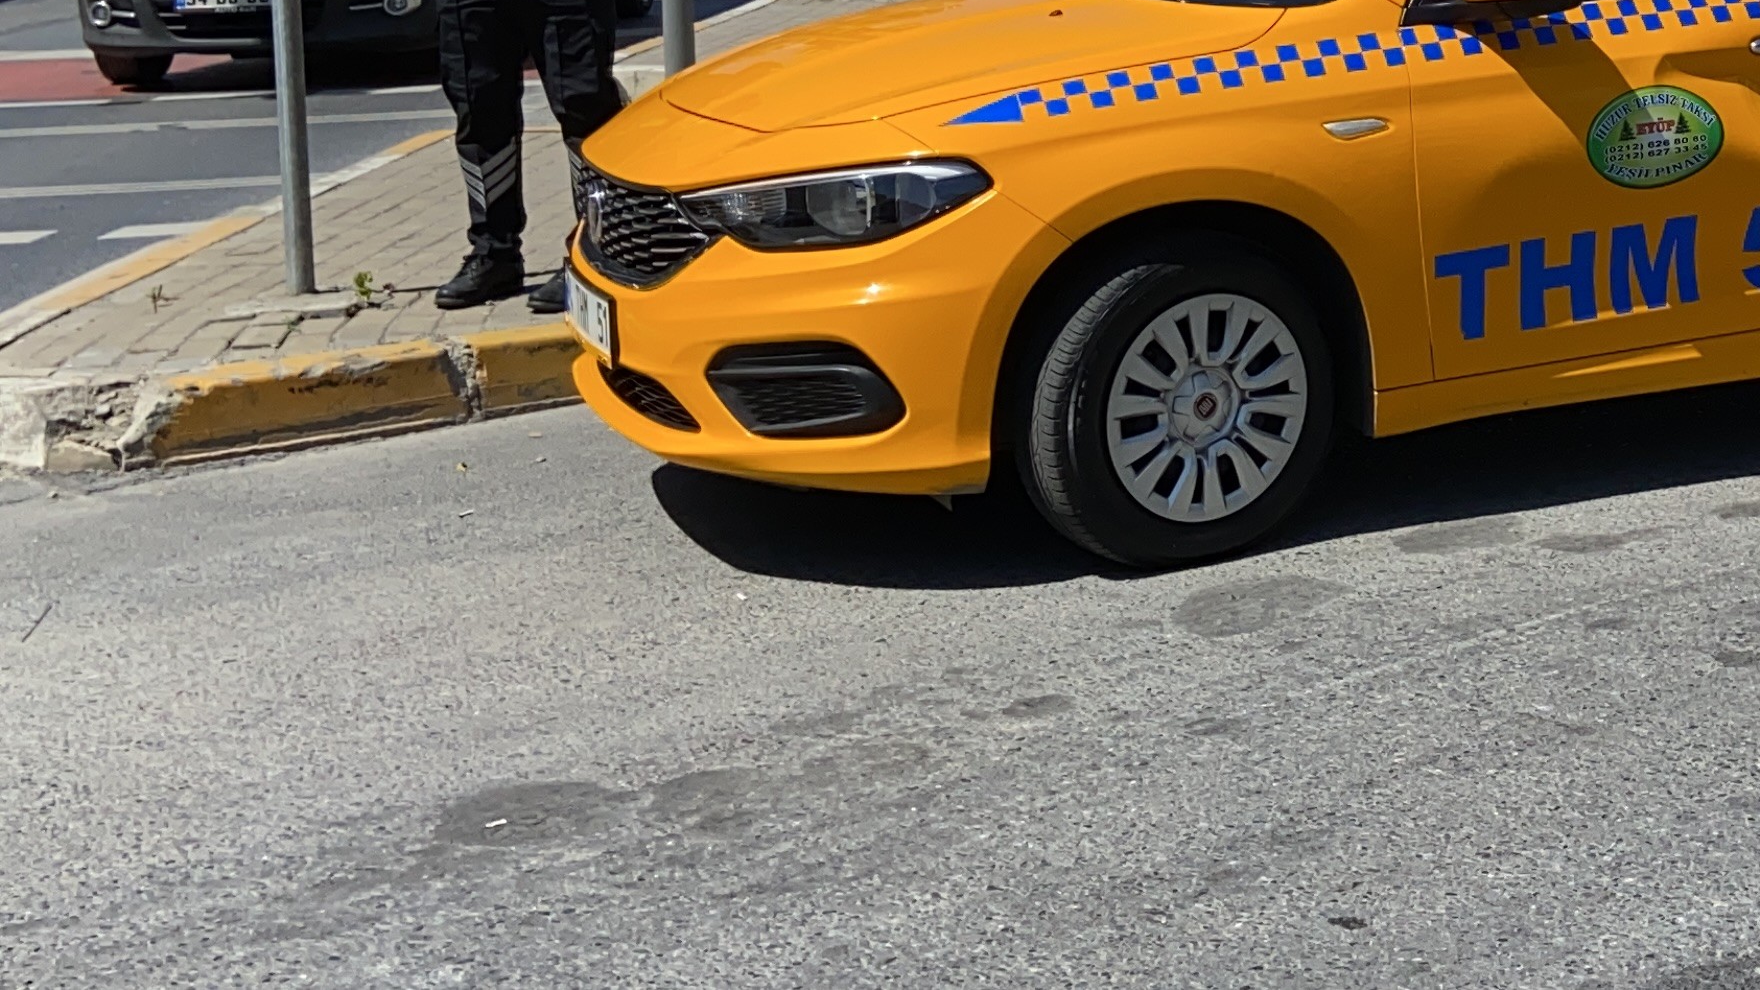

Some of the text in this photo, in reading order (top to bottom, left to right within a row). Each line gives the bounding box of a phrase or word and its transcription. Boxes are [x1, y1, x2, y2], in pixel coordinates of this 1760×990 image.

[1594, 91, 1716, 141] HUZUR TELSİZ TAKSİ
[1636, 118, 1675, 136] EYÜP
[1604, 142, 1644, 155] (0212)
[1604, 143, 1708, 164] (0212) 627 33 45
[1434, 215, 1700, 340] THM
